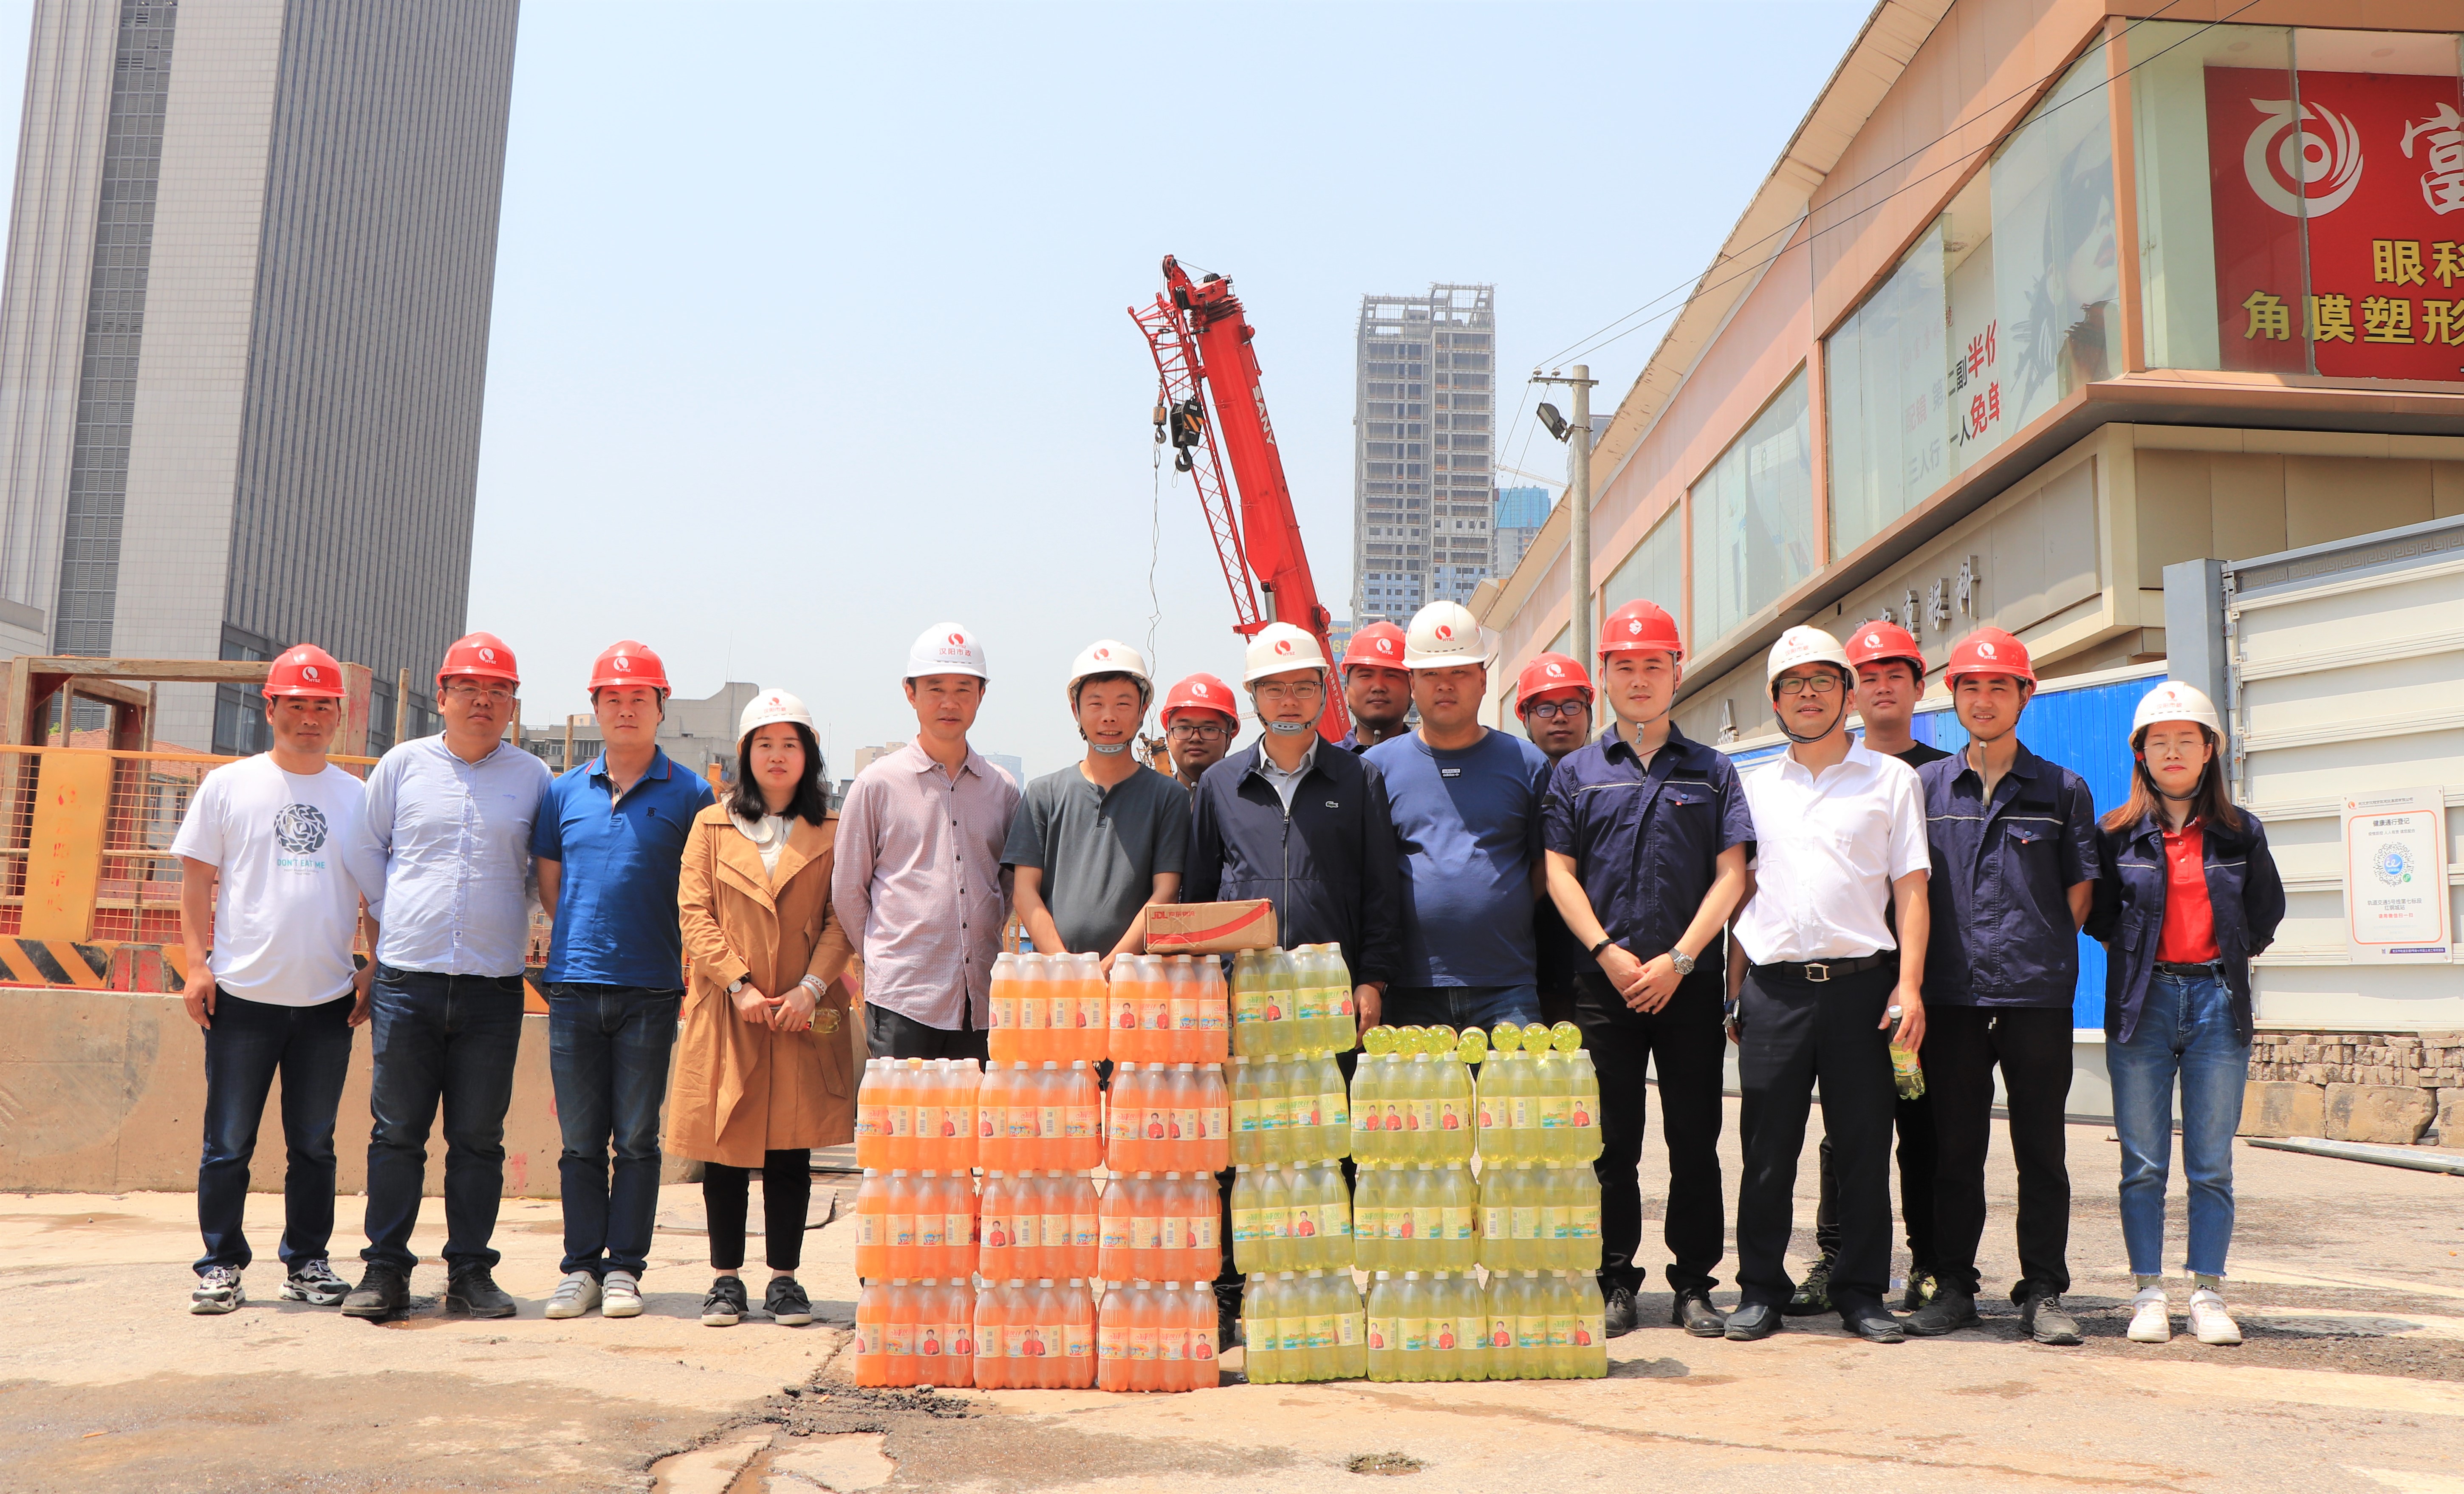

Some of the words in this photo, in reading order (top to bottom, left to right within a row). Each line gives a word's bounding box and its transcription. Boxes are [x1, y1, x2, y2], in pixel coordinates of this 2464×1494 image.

[2242, 291, 2464, 346] 角膜塑形
[1252, 385, 1275, 445] SANY
[1908, 437, 1940, 486] 三人行
[939, 648, 971, 657] 汉阳市政
[1785, 645, 1808, 655] 汉阳市政
[2373, 818, 2410, 827] 健康通行登记
[315, 861, 325, 869] ME
[1151, 911, 1168, 919] JDL
